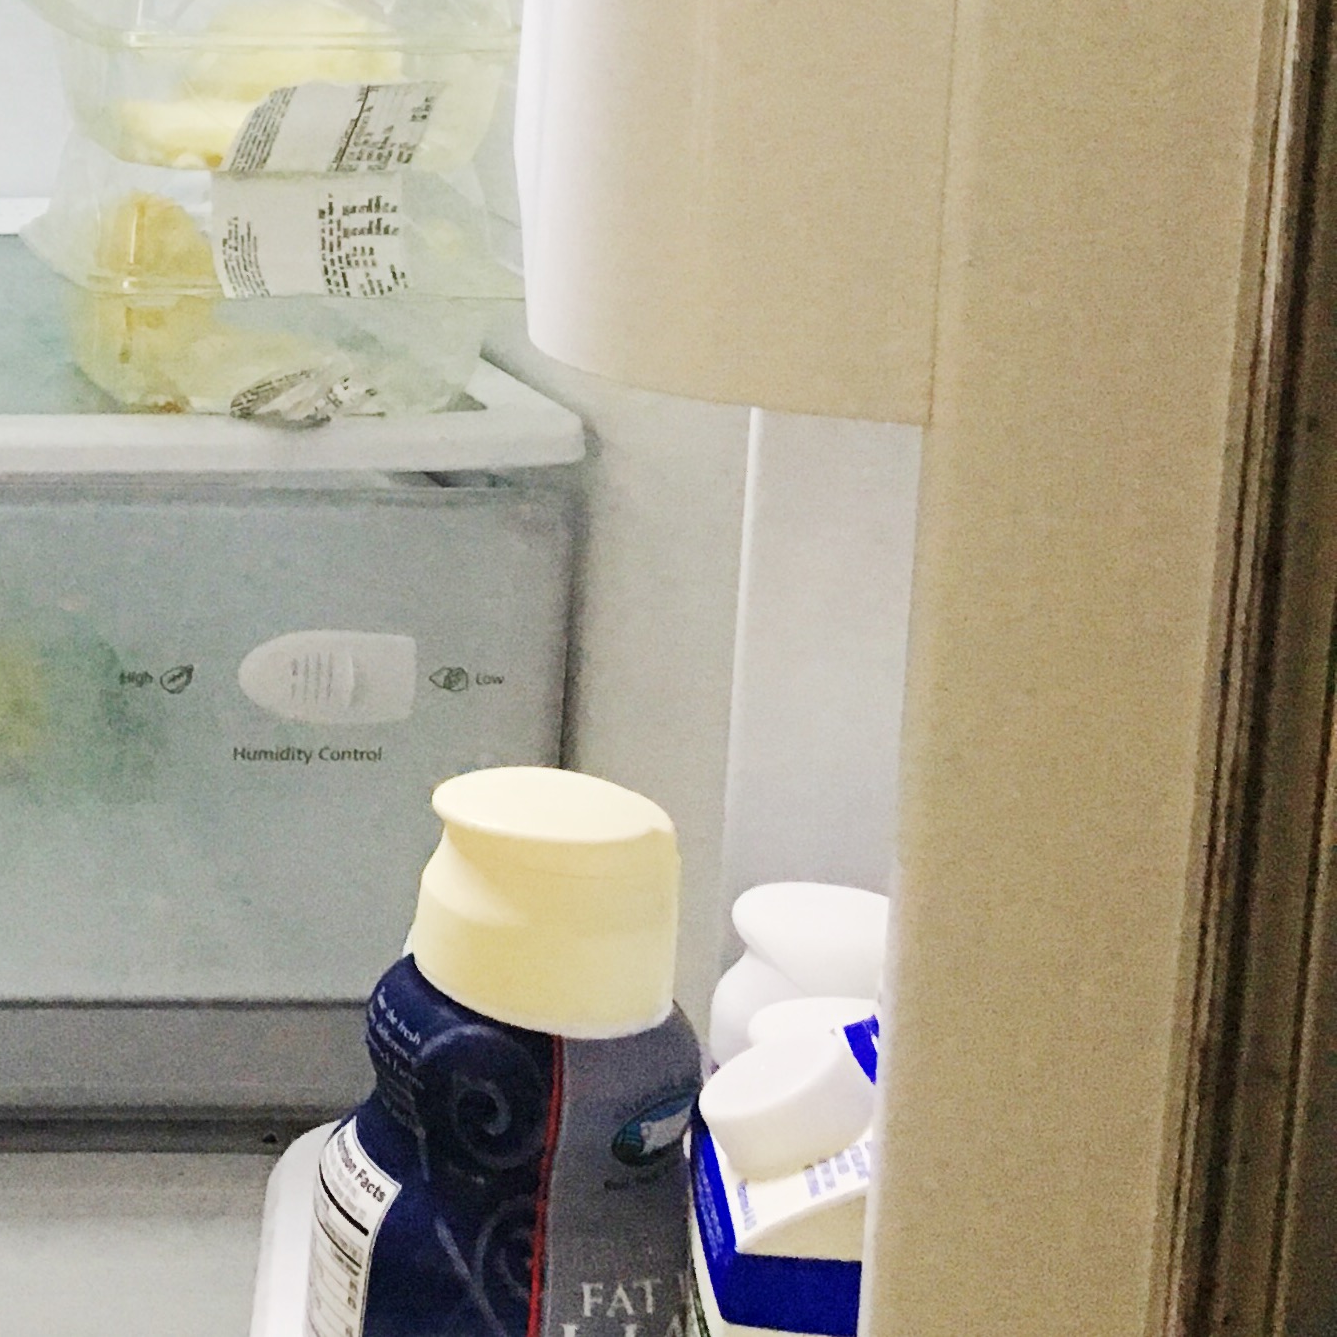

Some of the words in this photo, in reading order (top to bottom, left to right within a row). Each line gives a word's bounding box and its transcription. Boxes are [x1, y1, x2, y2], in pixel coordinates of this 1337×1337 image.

[475, 672, 506, 687] Low
[231, 746, 313, 765] Humidity
[318, 746, 383, 763] Control
[355, 1167, 386, 1204] Facts
[581, 1277, 663, 1318] FAT
